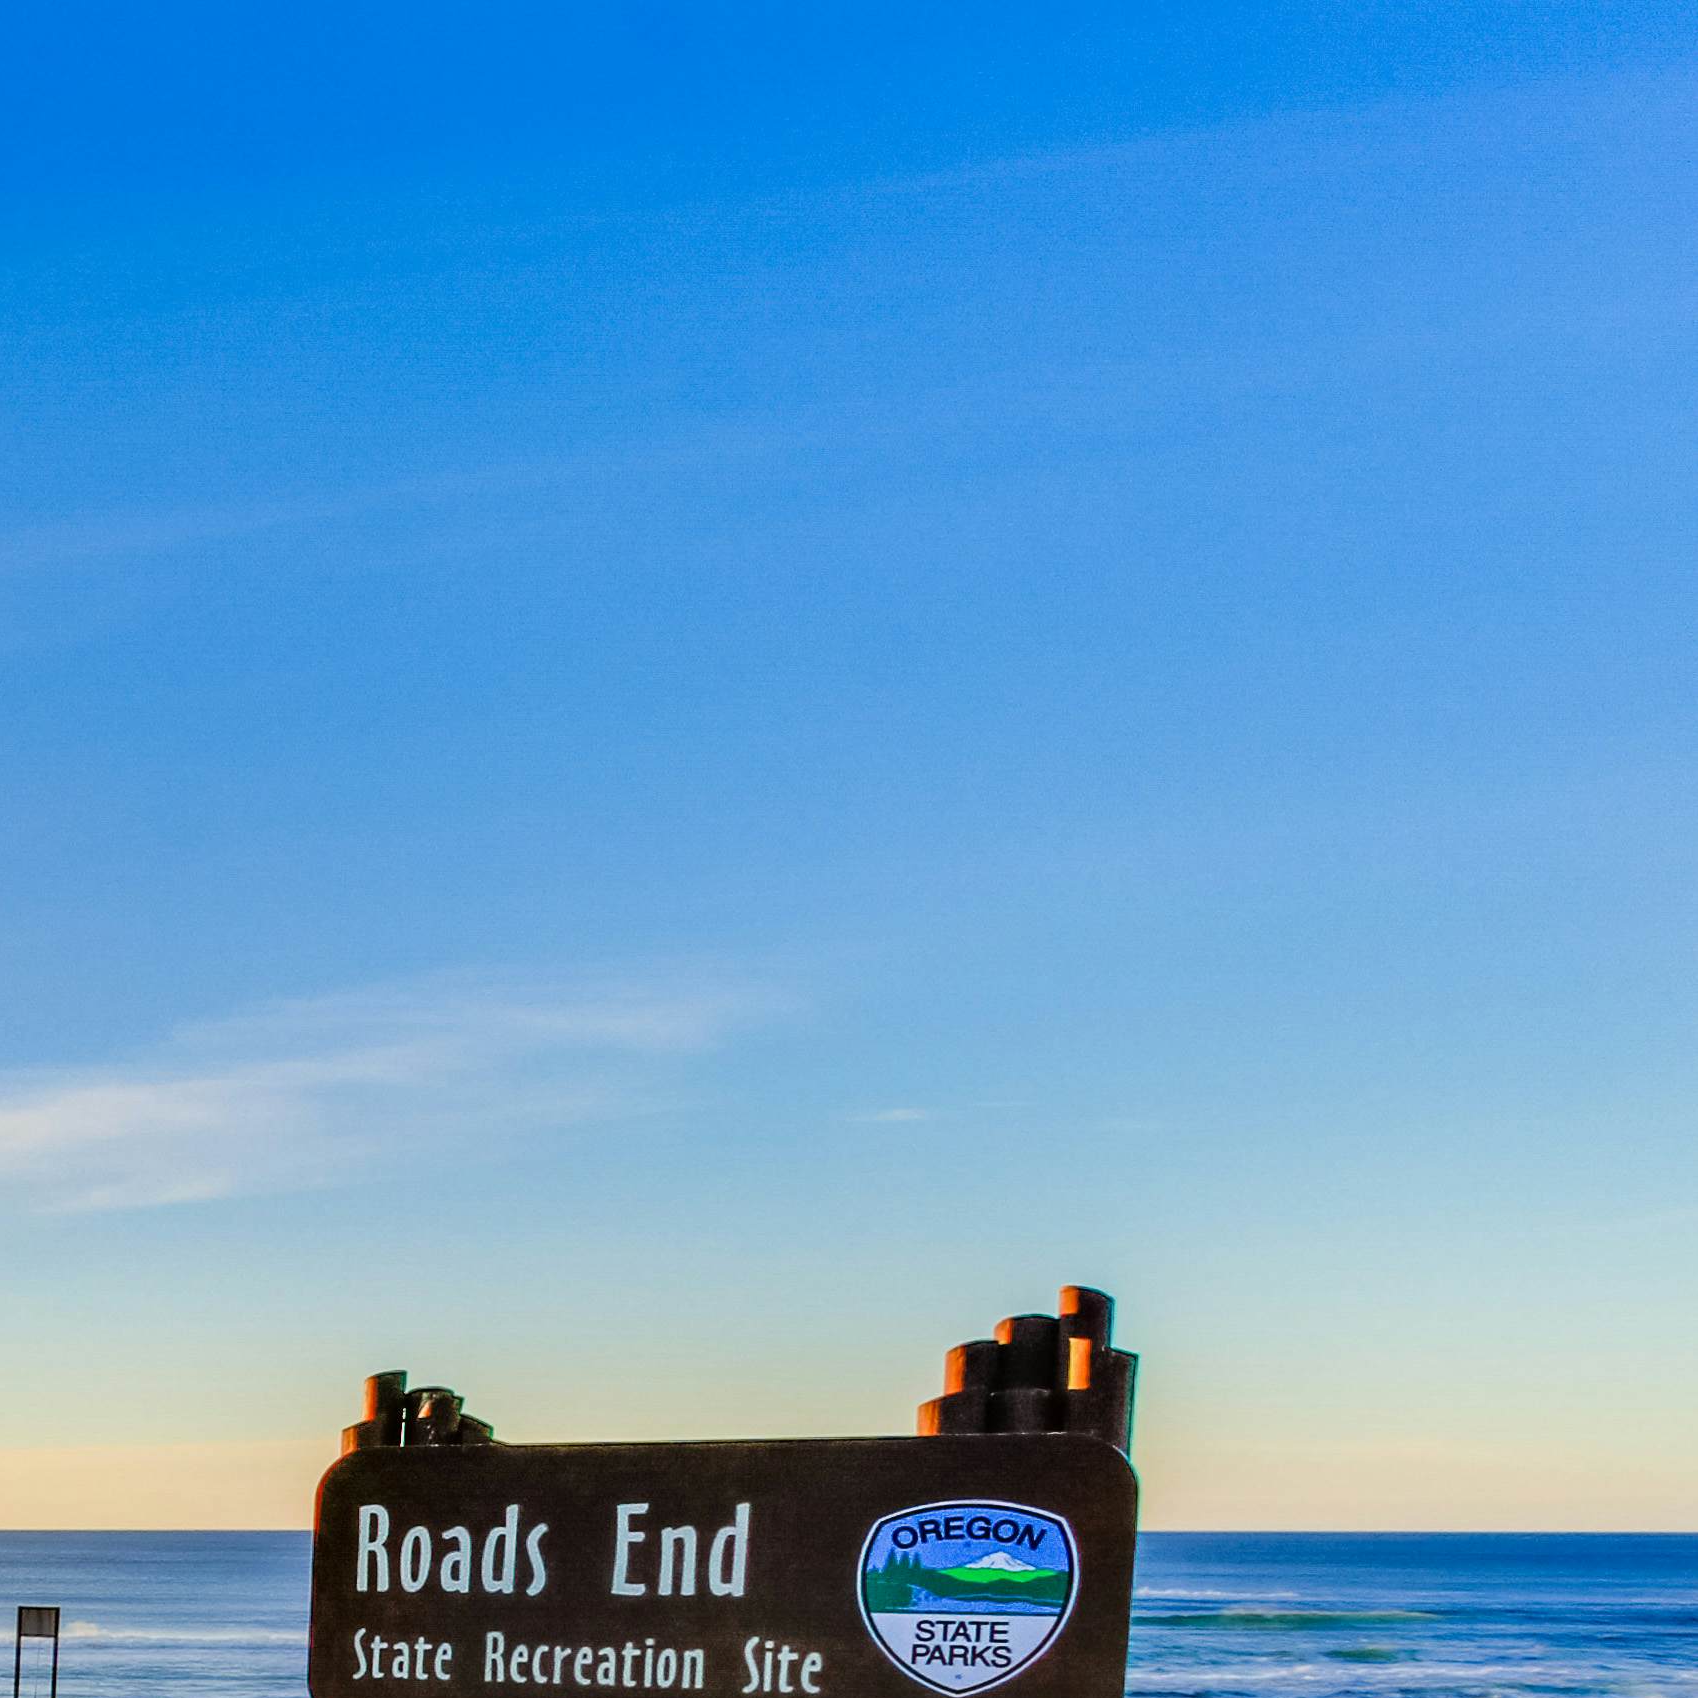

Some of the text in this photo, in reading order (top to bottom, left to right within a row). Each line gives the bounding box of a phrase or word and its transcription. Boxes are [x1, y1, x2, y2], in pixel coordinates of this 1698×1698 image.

[355, 1501, 751, 1598] Roads End
[891, 1515, 1048, 1551] OREGON
[915, 1619, 1010, 1643] STATE
[352, 1627, 823, 1694] State Recreation Site
[911, 1643, 1012, 1668] PARKS
